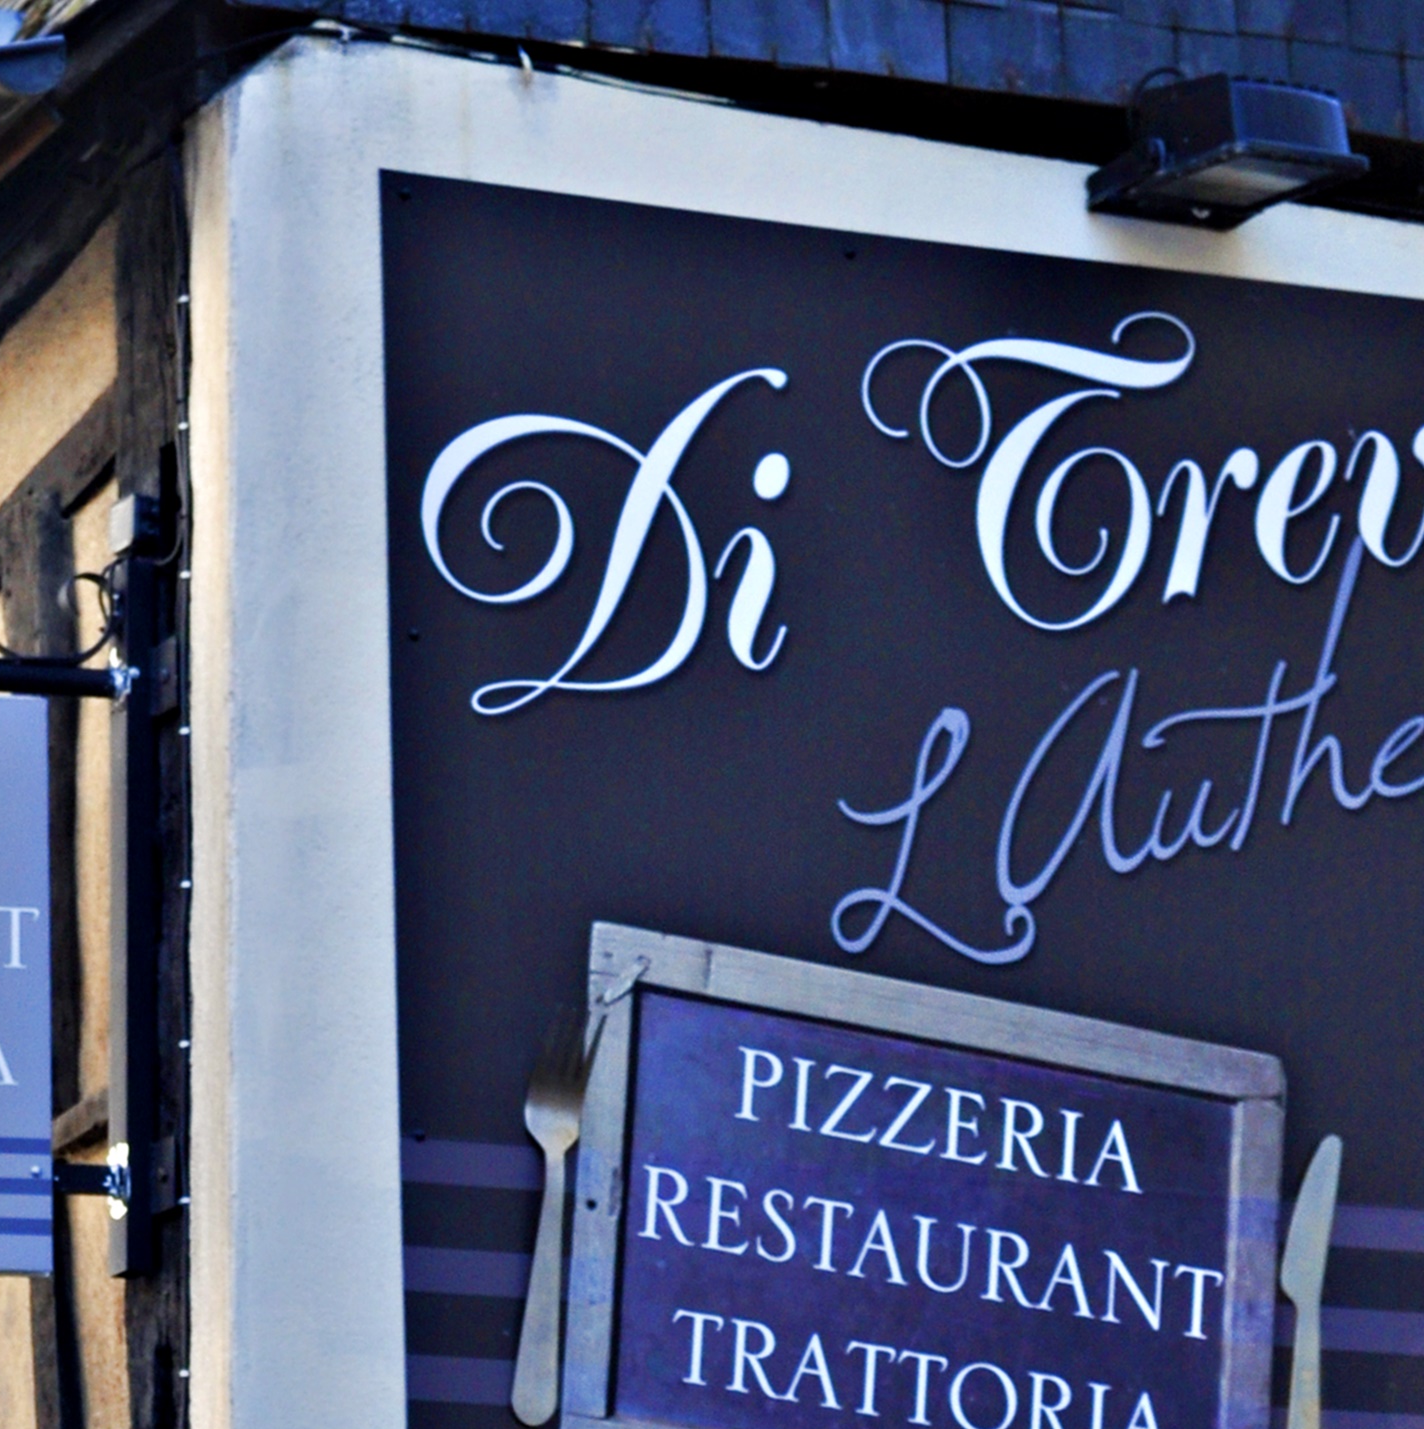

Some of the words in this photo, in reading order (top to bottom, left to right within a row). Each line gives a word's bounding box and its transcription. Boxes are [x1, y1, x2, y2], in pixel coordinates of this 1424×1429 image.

[421, 367, 788, 714] Di
[734, 1046, 1144, 1194] PIZZERIA
[637, 1165, 1224, 1340] RESTAURANT
